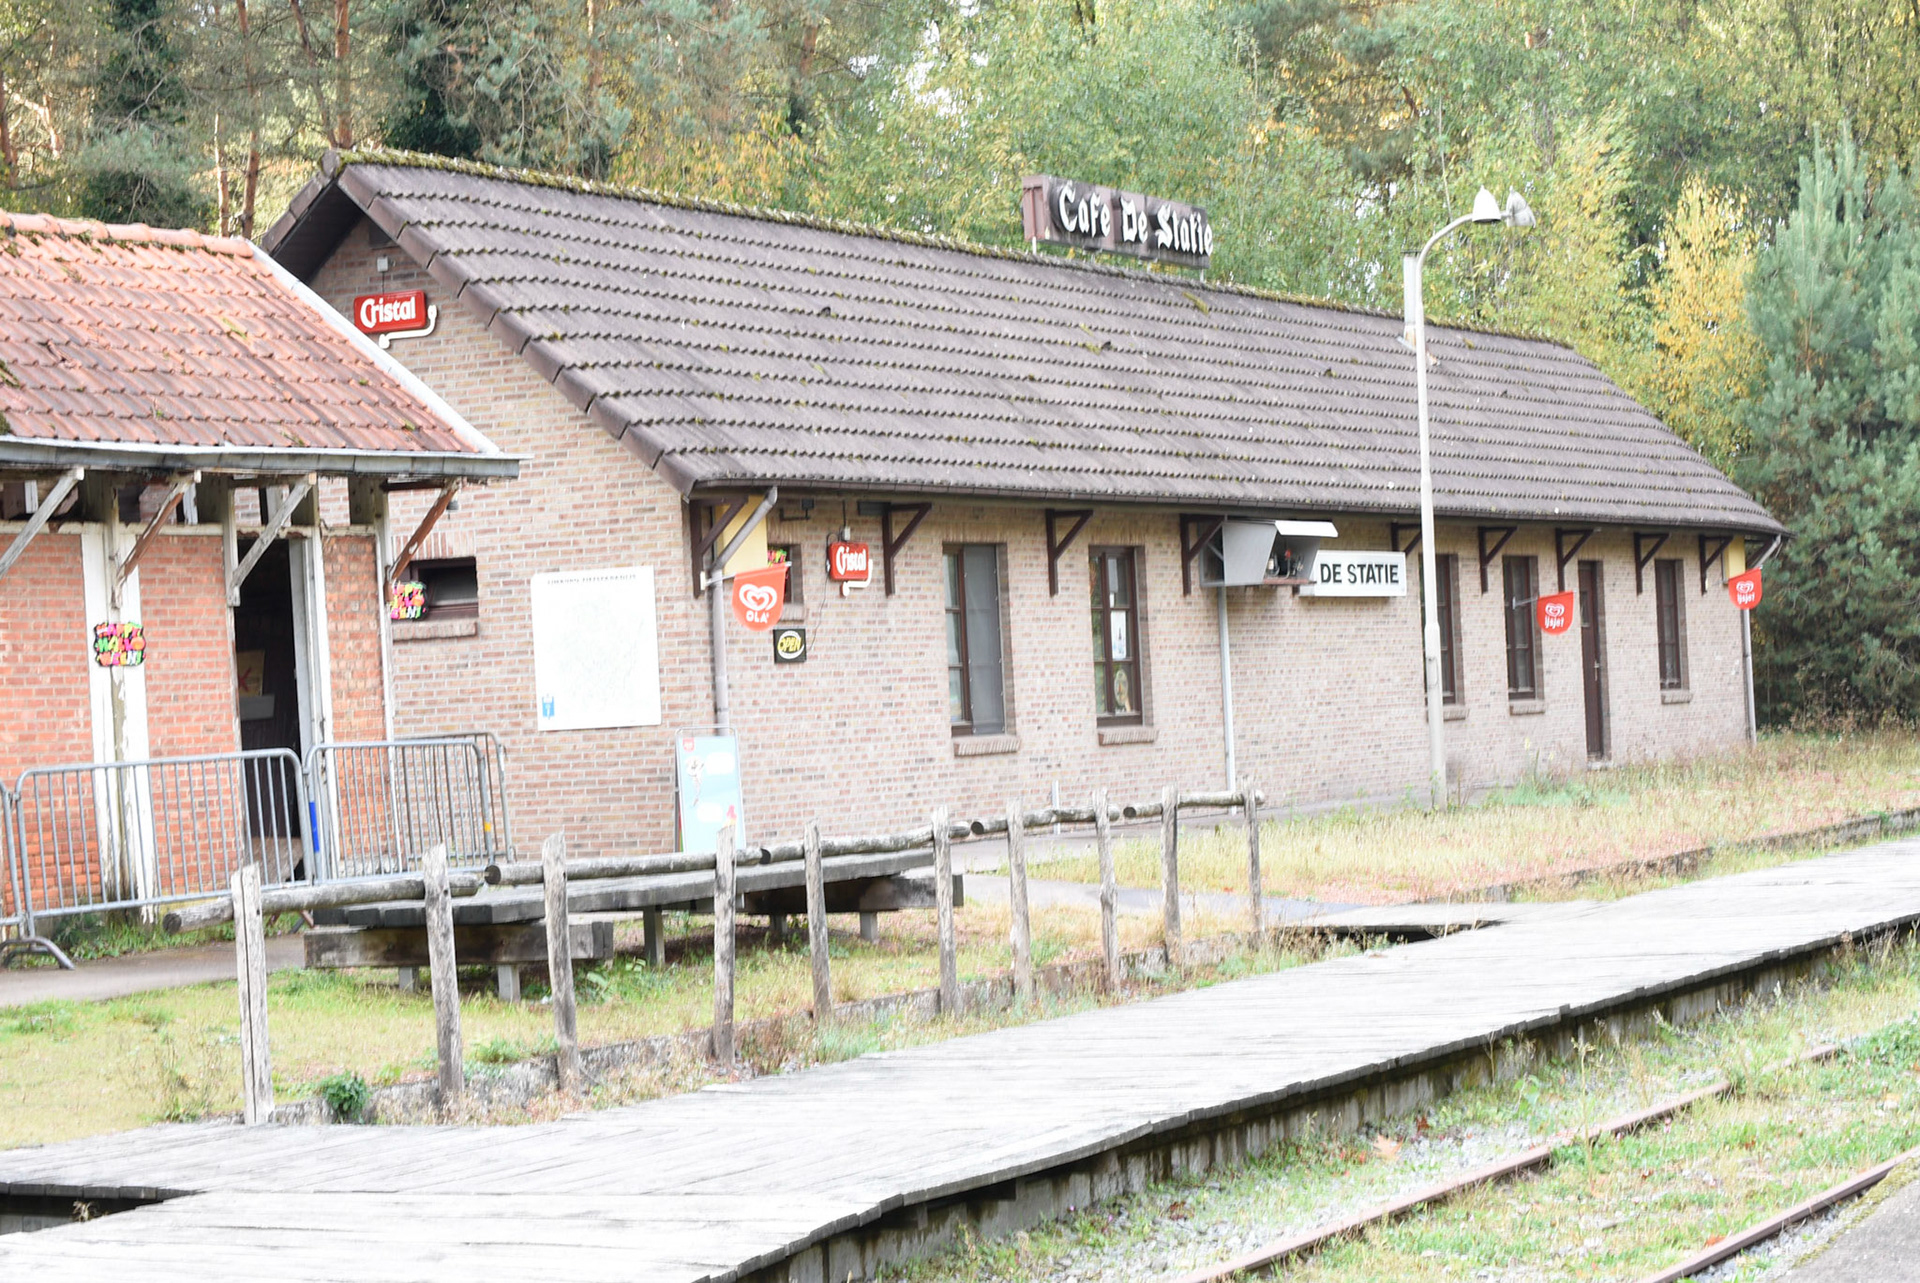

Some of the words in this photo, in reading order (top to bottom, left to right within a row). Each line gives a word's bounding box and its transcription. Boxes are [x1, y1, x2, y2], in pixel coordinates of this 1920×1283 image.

[1120, 196, 1148, 244] De
[1155, 204, 1214, 257] Statie
[360, 296, 416, 329] Cristal
[836, 546, 867, 575] Cristal
[1320, 563, 1342, 584] DE
[1347, 563, 1399, 584] STATIE
[777, 637, 801, 652] OPEN
